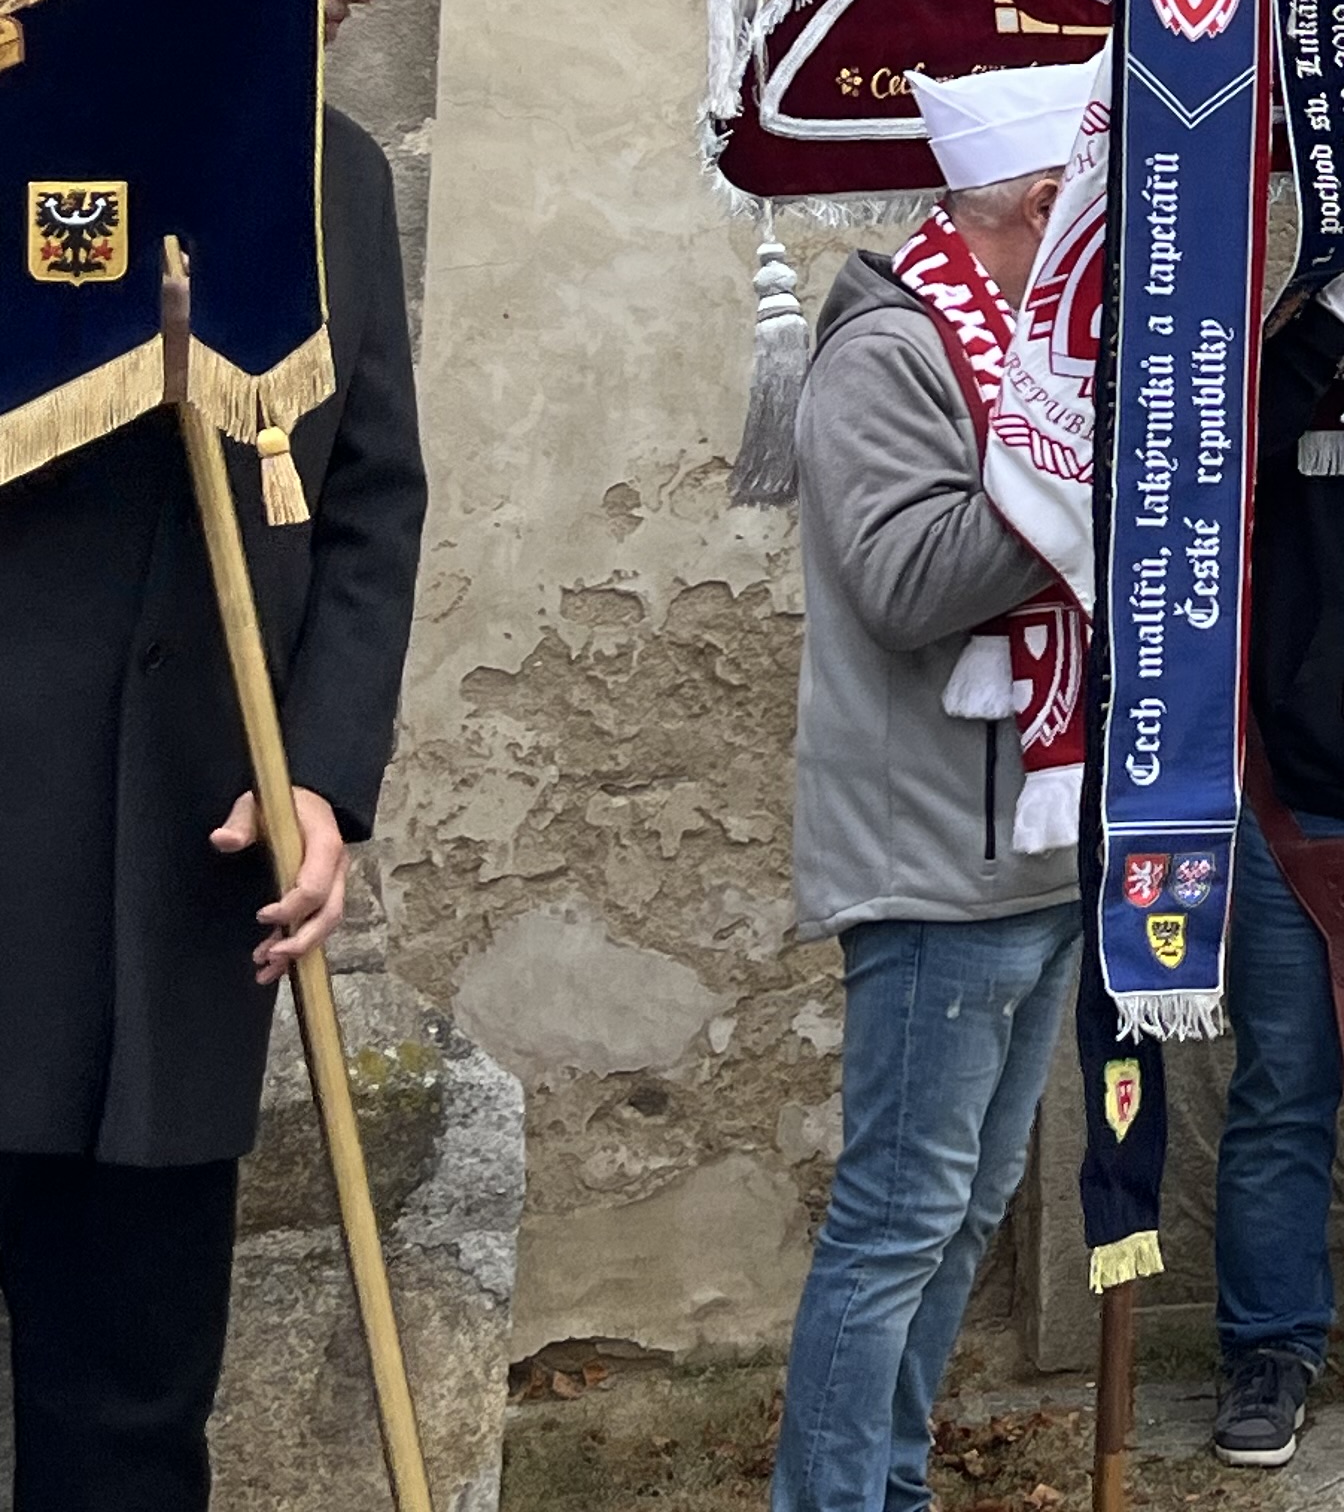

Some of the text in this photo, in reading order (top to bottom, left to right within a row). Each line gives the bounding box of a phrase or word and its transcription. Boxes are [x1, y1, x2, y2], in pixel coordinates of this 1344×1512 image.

[1303, 91, 1332, 132] sv.
[1309, 143, 1344, 235] pochod
[1124, 152, 1183, 787] Cech malířů, lakýrníků a tapetářů
[1173, 318, 1235, 630] České republiky
